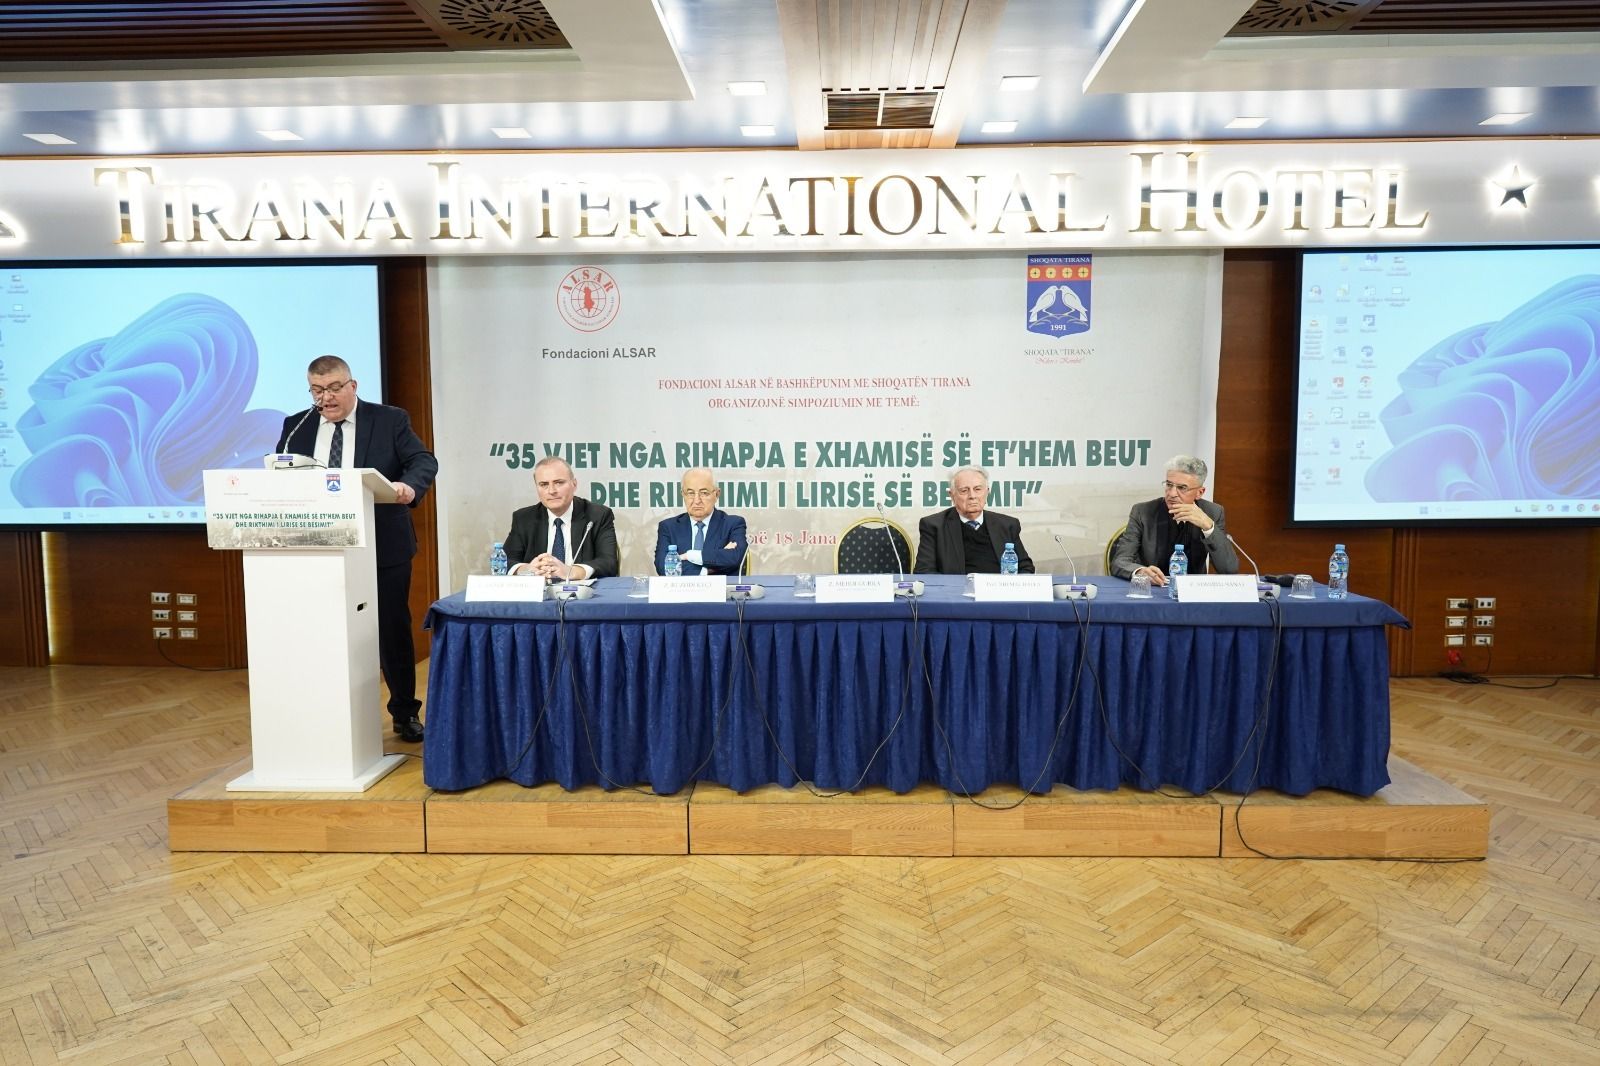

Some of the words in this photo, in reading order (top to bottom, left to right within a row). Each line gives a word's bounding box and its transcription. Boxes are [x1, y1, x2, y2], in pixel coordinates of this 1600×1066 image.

[94, 167, 412, 244] TIRANA
[428, 161, 1110, 240] INTERNATIONAL
[1129, 151, 1430, 233] HOTEL
[562, 269, 614, 295] ALSAR
[542, 348, 609, 359] Fondacioni
[612, 347, 656, 358] ALSAR
[1024, 349, 1059, 357] SHOQATA
[658, 379, 721, 390] FONDACIONI
[724, 379, 757, 389] ALSAR
[760, 376, 774, 389] NË
[776, 376, 850, 389] BASHKËPUNIM
[853, 378, 870, 388] ME
[872, 375, 929, 391] SHOQATËN
[931, 377, 971, 388] TIRANA
[708, 396, 786, 409] ORGANIZOJNË
[788, 397, 863, 408] SIMPOZIUMIN
[866, 397, 883, 408] ME
[886, 395, 920, 407] TEMË:
[490, 443, 536, 469] "35
[610, 442, 667, 469] NGA
[675, 441, 785, 468] RIHAPJA
[794, 442, 807, 468] E
[815, 432, 933, 468] XHAMISË
[942, 432, 971, 468] SË
[981, 440, 1076, 467] ET'HEM
[1086, 440, 1151, 467] BEUT
[590, 482, 640, 508] DHE
[779, 481, 786, 508] I
[796, 473, 875, 508] LIRISË
[883, 473, 913, 508] SË
[922, 480, 1042, 508] BEMIT"
[776, 532, 793, 545] 18
[799, 530, 837, 545] Jana
